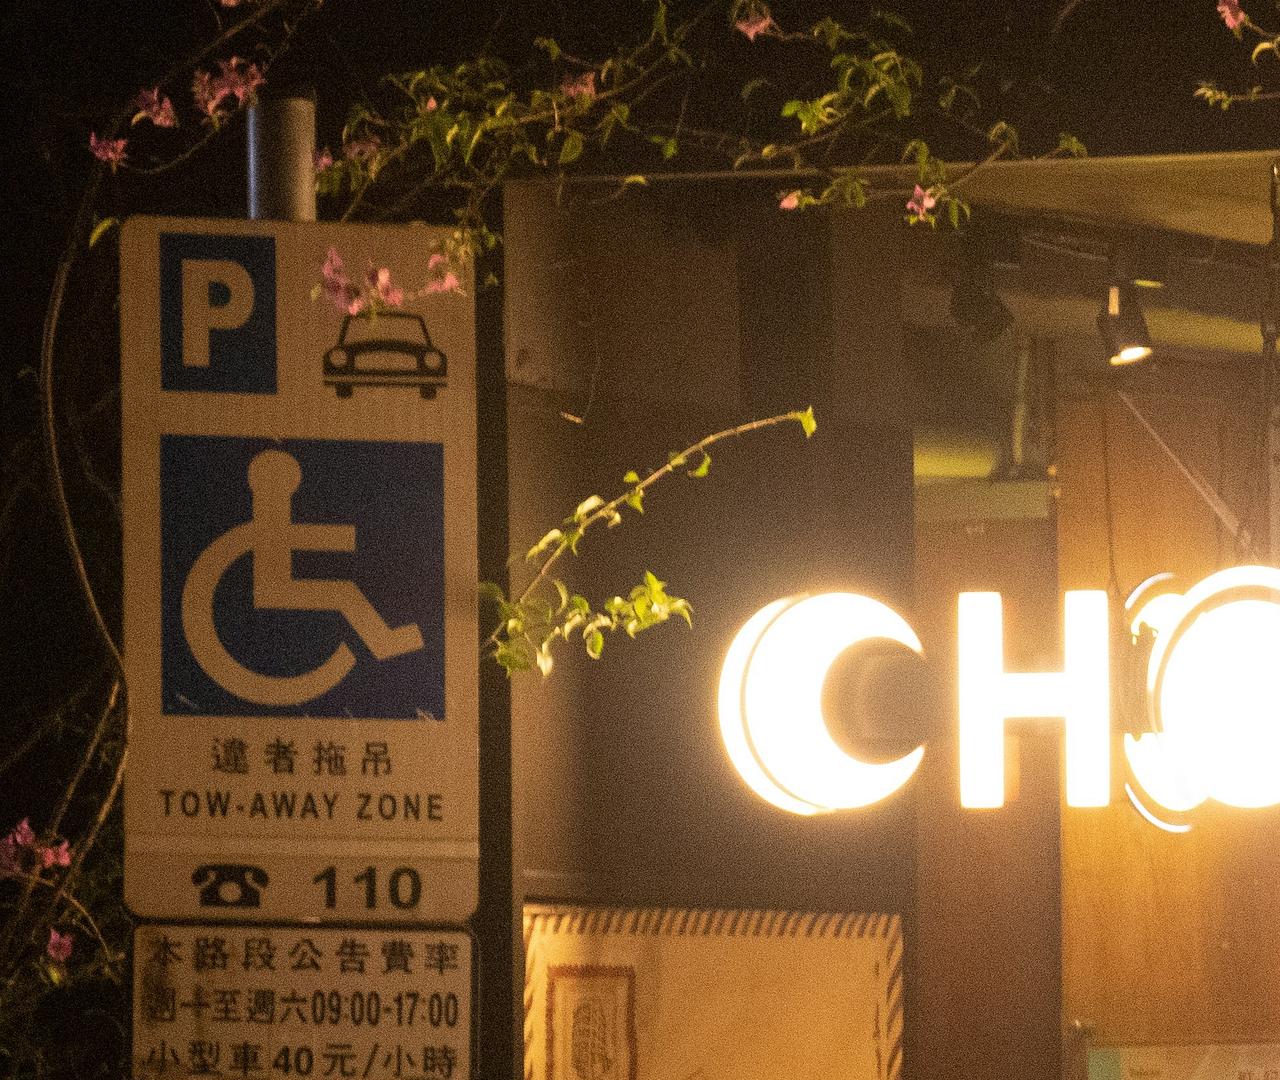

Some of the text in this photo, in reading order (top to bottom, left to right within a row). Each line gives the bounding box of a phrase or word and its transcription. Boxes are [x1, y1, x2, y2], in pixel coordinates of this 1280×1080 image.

[181, 258, 256, 368] P
[211, 736, 393, 777] 違者拖吊
[159, 789, 445, 822] TOW-AWAY ZONE
[312, 865, 423, 910] 110
[148, 936, 460, 976] 本路段公告費率
